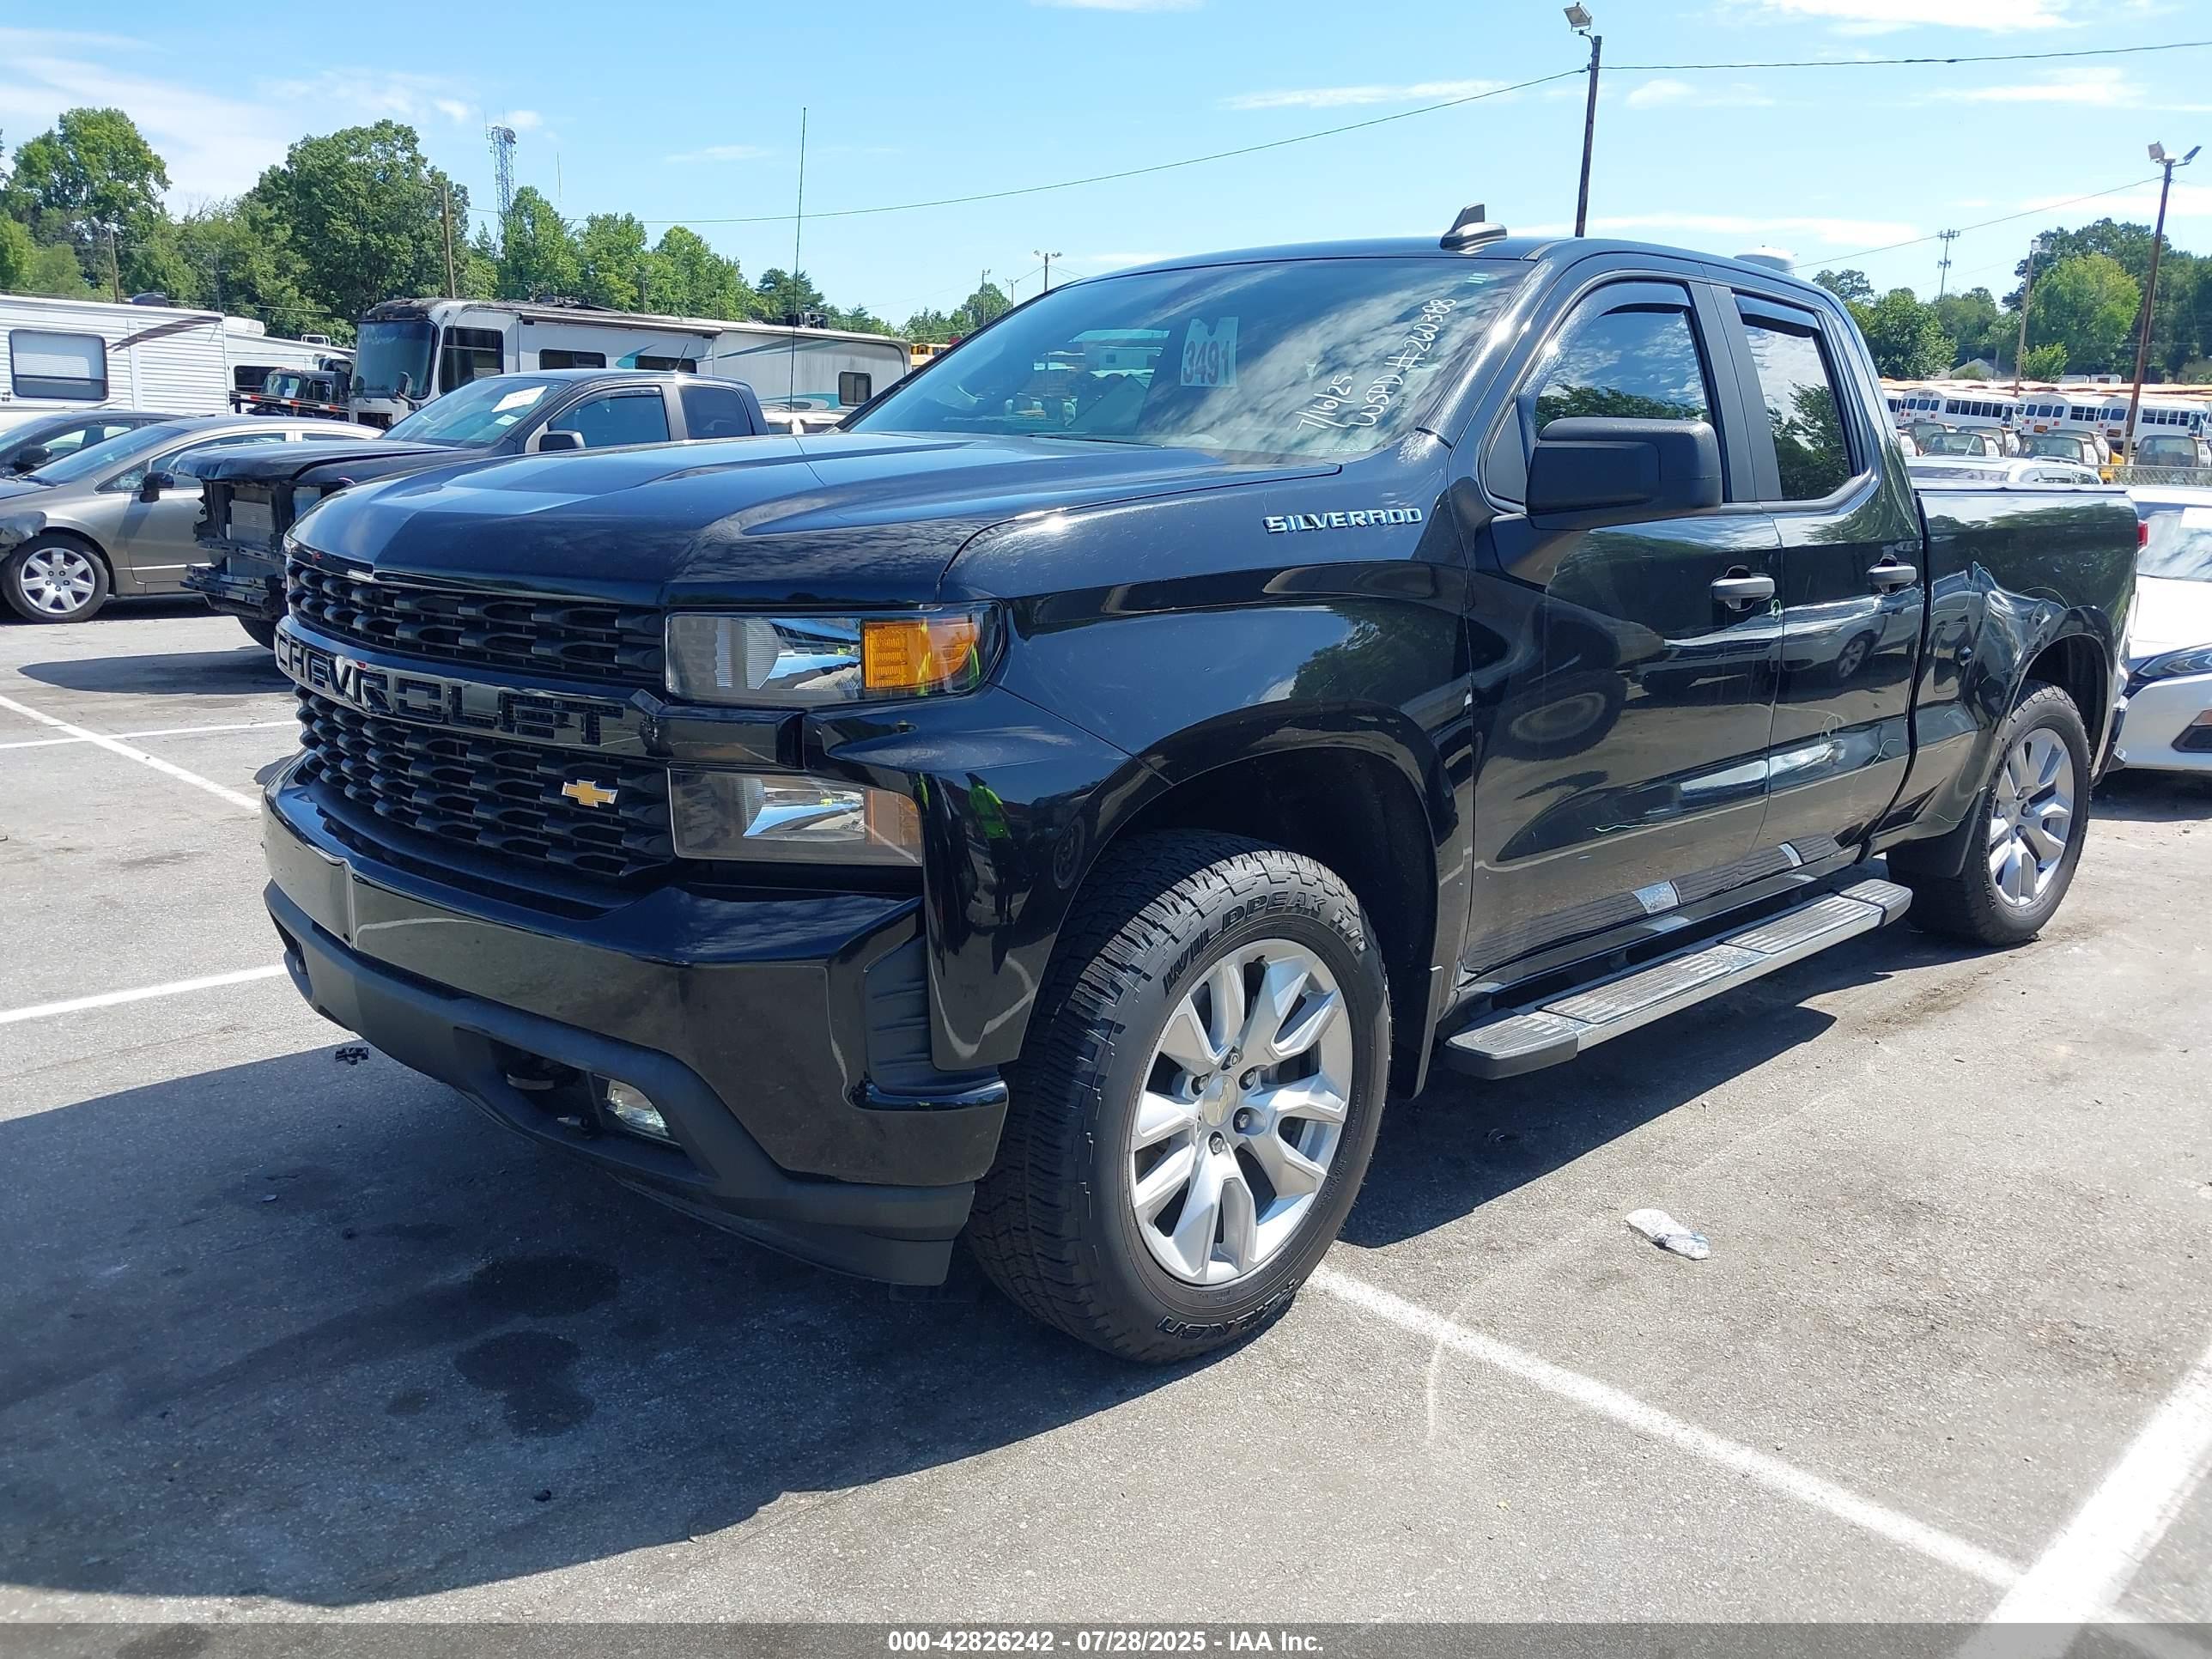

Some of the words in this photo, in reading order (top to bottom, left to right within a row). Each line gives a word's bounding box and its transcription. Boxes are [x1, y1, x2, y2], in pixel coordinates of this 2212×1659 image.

[1182, 340, 1231, 385] 3491
[1384, 298, 1457, 371] #260388
[1295, 374, 1355, 430] 7/16/25
[1264, 507, 1423, 534] SILVERADO
[274, 632, 626, 747] CHEVROLET
[1162, 891, 1328, 998] WILDPEAK
